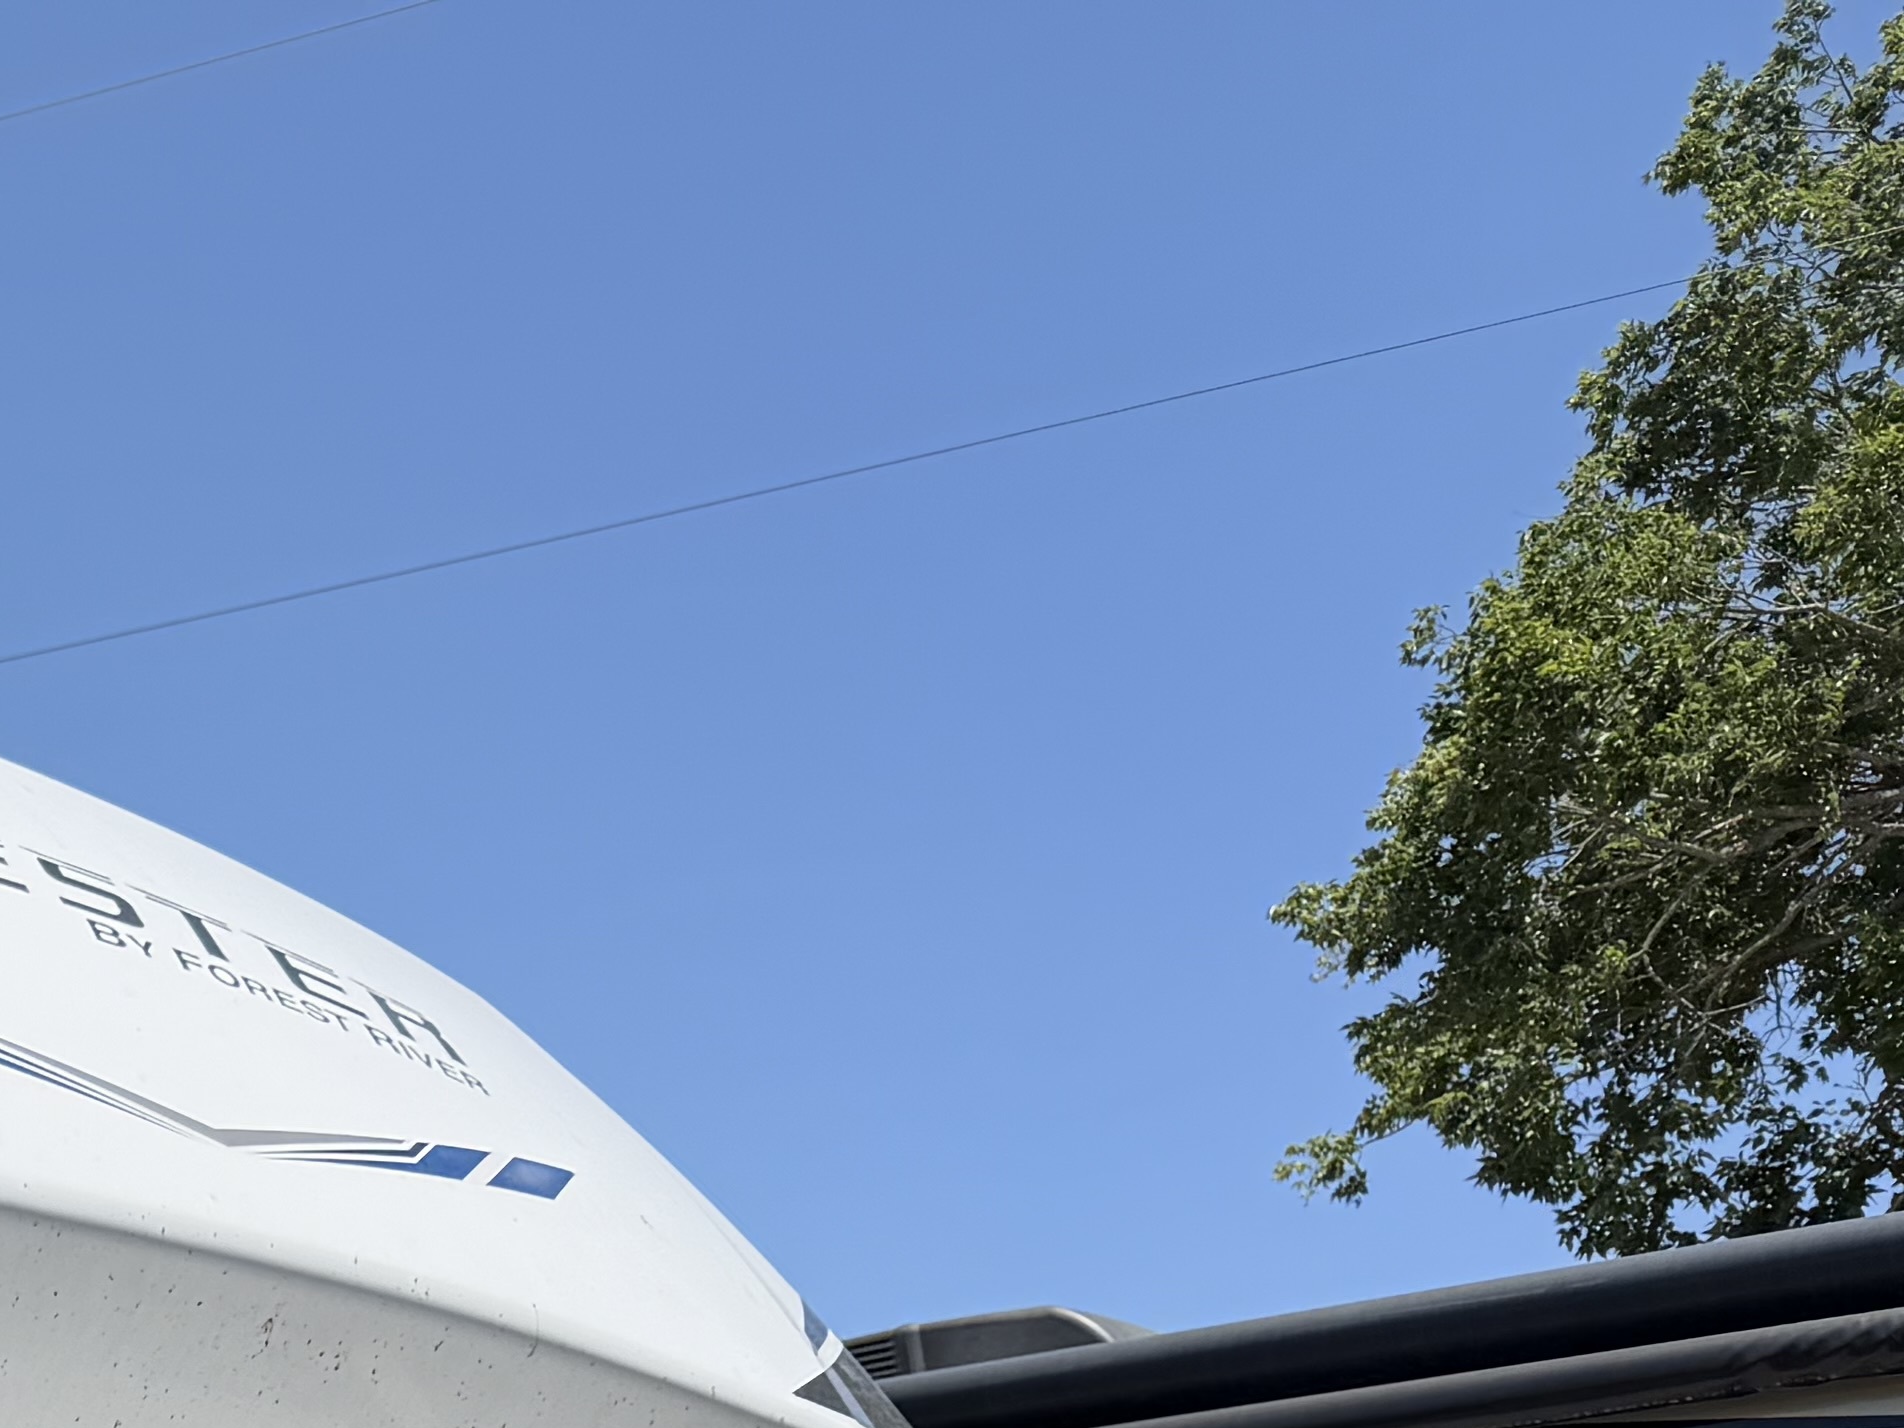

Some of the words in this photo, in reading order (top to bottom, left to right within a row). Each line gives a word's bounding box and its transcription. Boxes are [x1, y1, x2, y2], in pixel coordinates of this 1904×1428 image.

[86, 918, 153, 959] BY
[171, 947, 350, 1033] FOREST
[363, 1023, 491, 1097] RIVER
